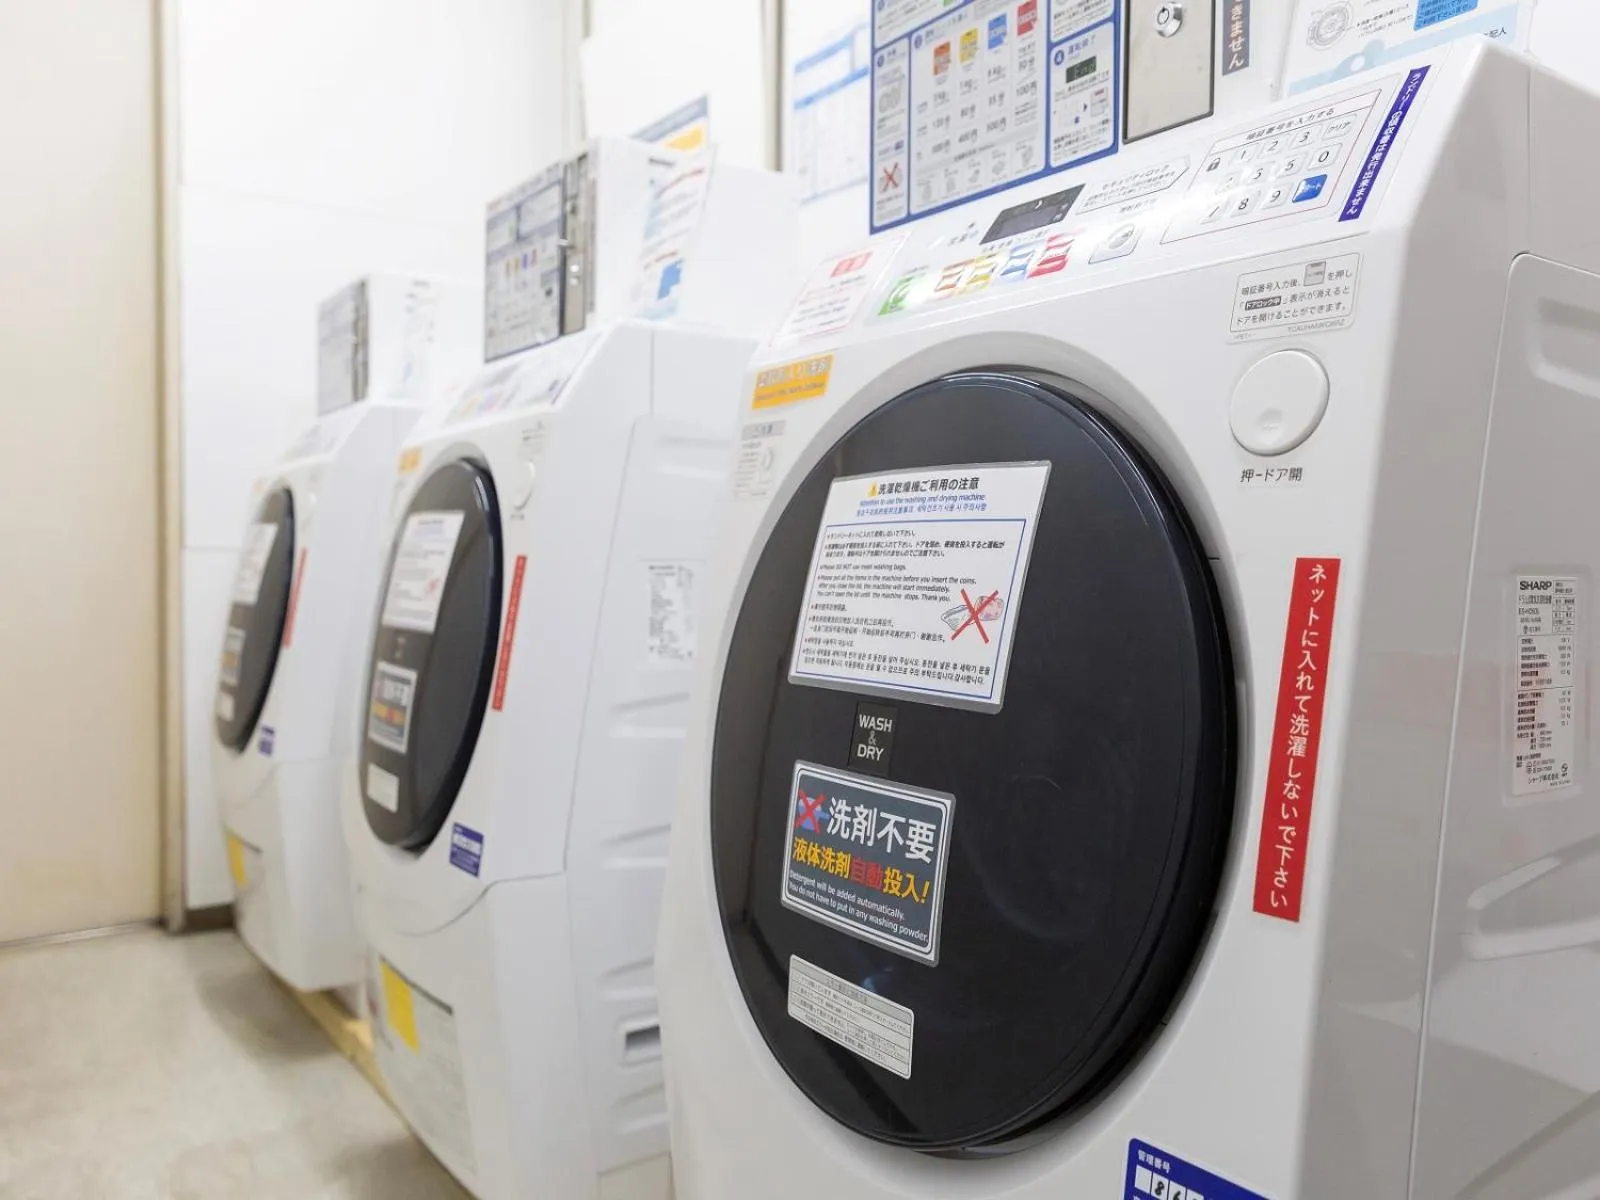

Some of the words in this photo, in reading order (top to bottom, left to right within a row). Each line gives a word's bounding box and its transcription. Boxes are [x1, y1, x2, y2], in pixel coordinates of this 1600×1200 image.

[1267, 140, 1278, 152] 2
[1299, 131, 1310, 143] 3
[1318, 150, 1330, 163] 0
[1238, 197, 1249, 210] 8
[1271, 190, 1281, 203] 9
[878, 477, 980, 495] 洗濯乾燥機ご利用の注意
[1519, 580, 1552, 591] SHARP
[921, 593, 938, 601] Thank
[909, 667, 920, 676] 주의
[960, 664, 977, 674] 세탁기
[859, 714, 893, 733] WASH
[868, 731, 877, 744] &
[1270, 562, 1328, 910] ネットに入れて洗濯しないで下さい
[857, 744, 884, 762] DRY
[827, 796, 937, 864] 洗剤不要
[789, 869, 815, 888] Detergent
[816, 881, 827, 892] will
[827, 883, 836, 895] be
[836, 888, 856, 903] added
[856, 895, 905, 921] automatically.
[789, 880, 798, 892] You
[798, 884, 807, 895] do
[807, 888, 816, 899] not
[816, 890, 830, 906] have
[830, 897, 837, 908] to
[836, 900, 848, 913] put
[848, 903, 856, 915] in
[855, 908, 868, 922] any
[868, 910, 898, 933] washing
[898, 923, 930, 943] powder.
